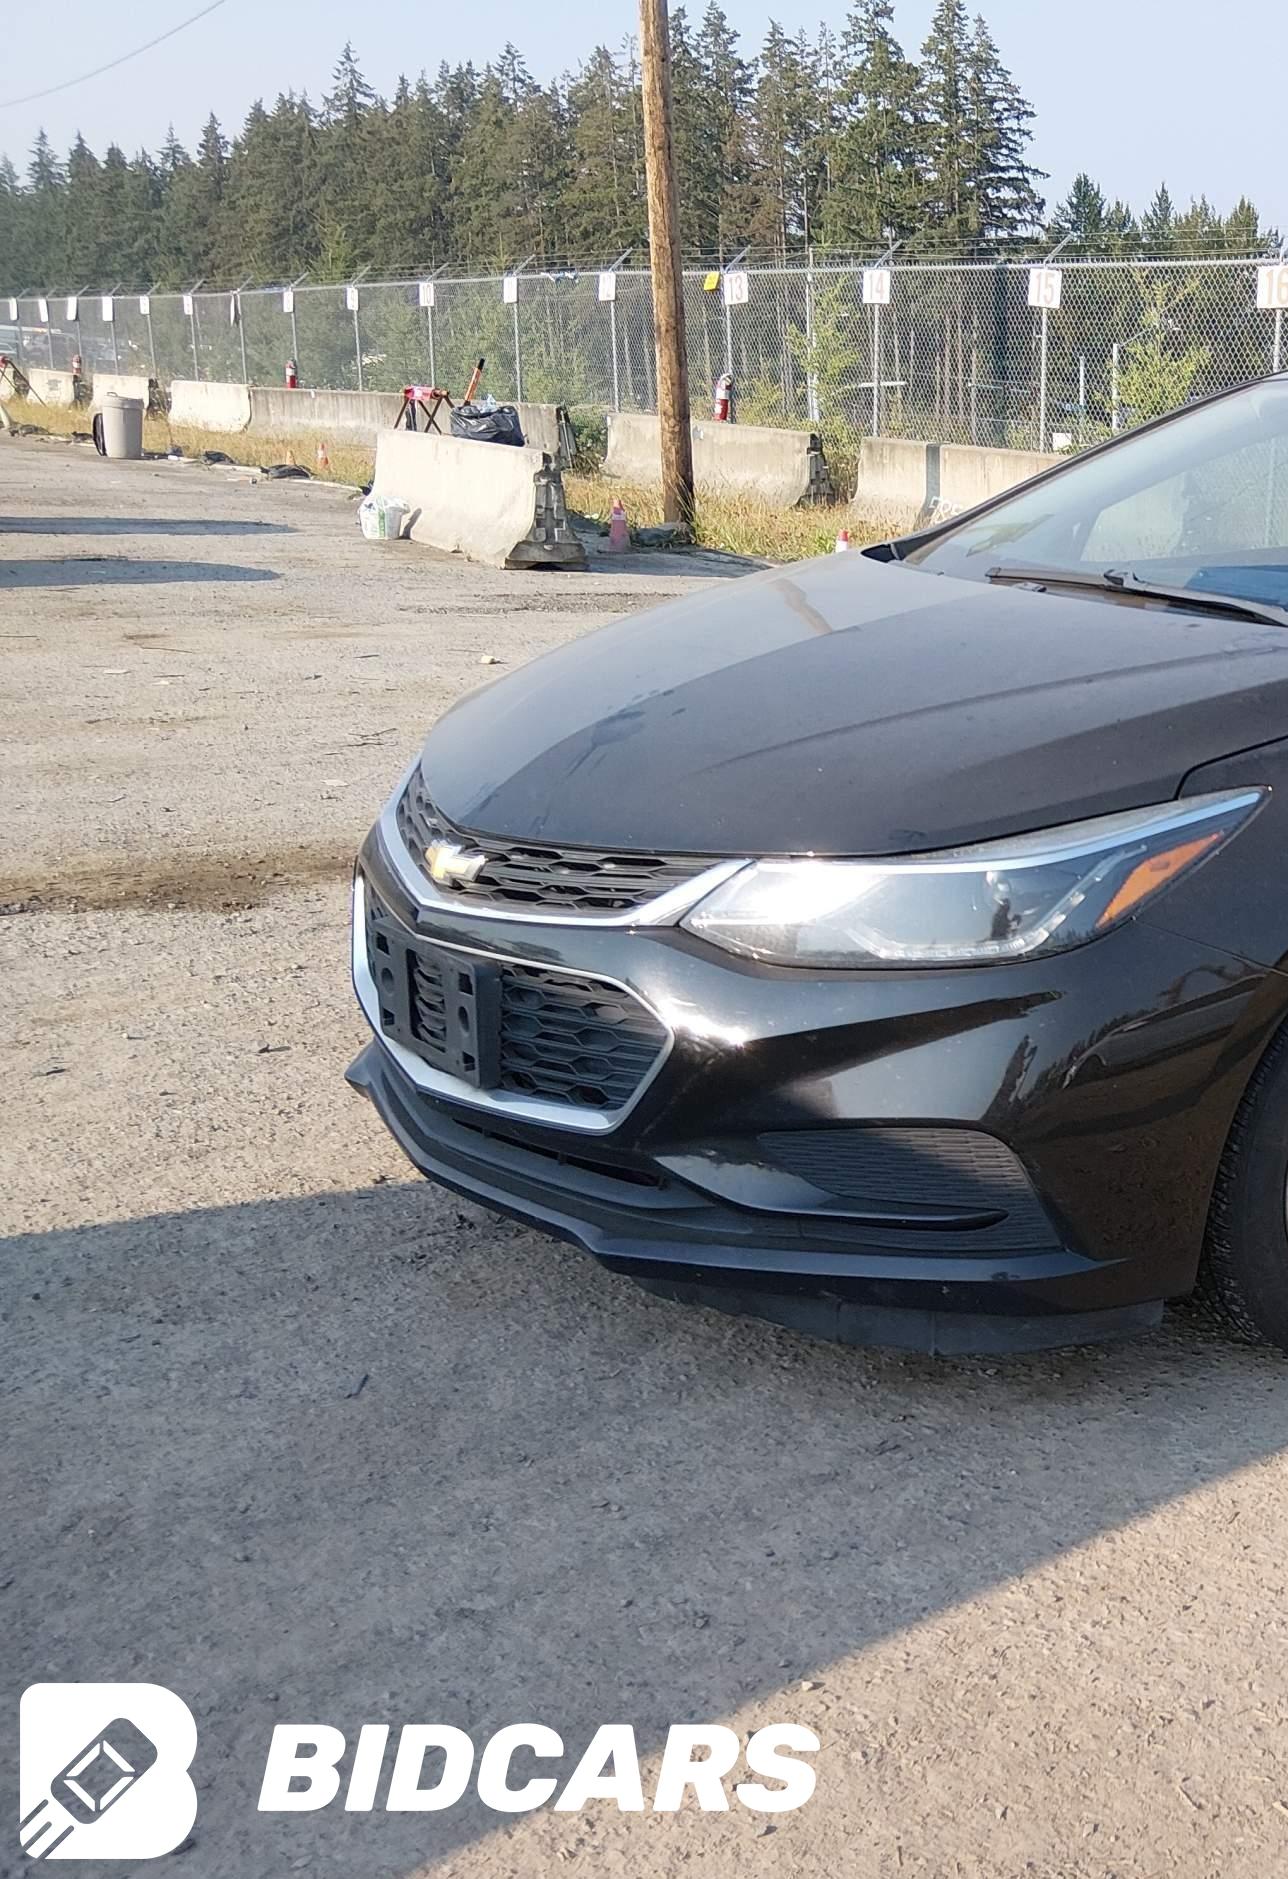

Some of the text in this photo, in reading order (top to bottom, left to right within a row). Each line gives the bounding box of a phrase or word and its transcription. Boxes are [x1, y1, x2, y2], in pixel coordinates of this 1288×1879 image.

[729, 275, 743, 302] 13
[869, 271, 885, 300] 14
[1036, 271, 1055, 305] 15
